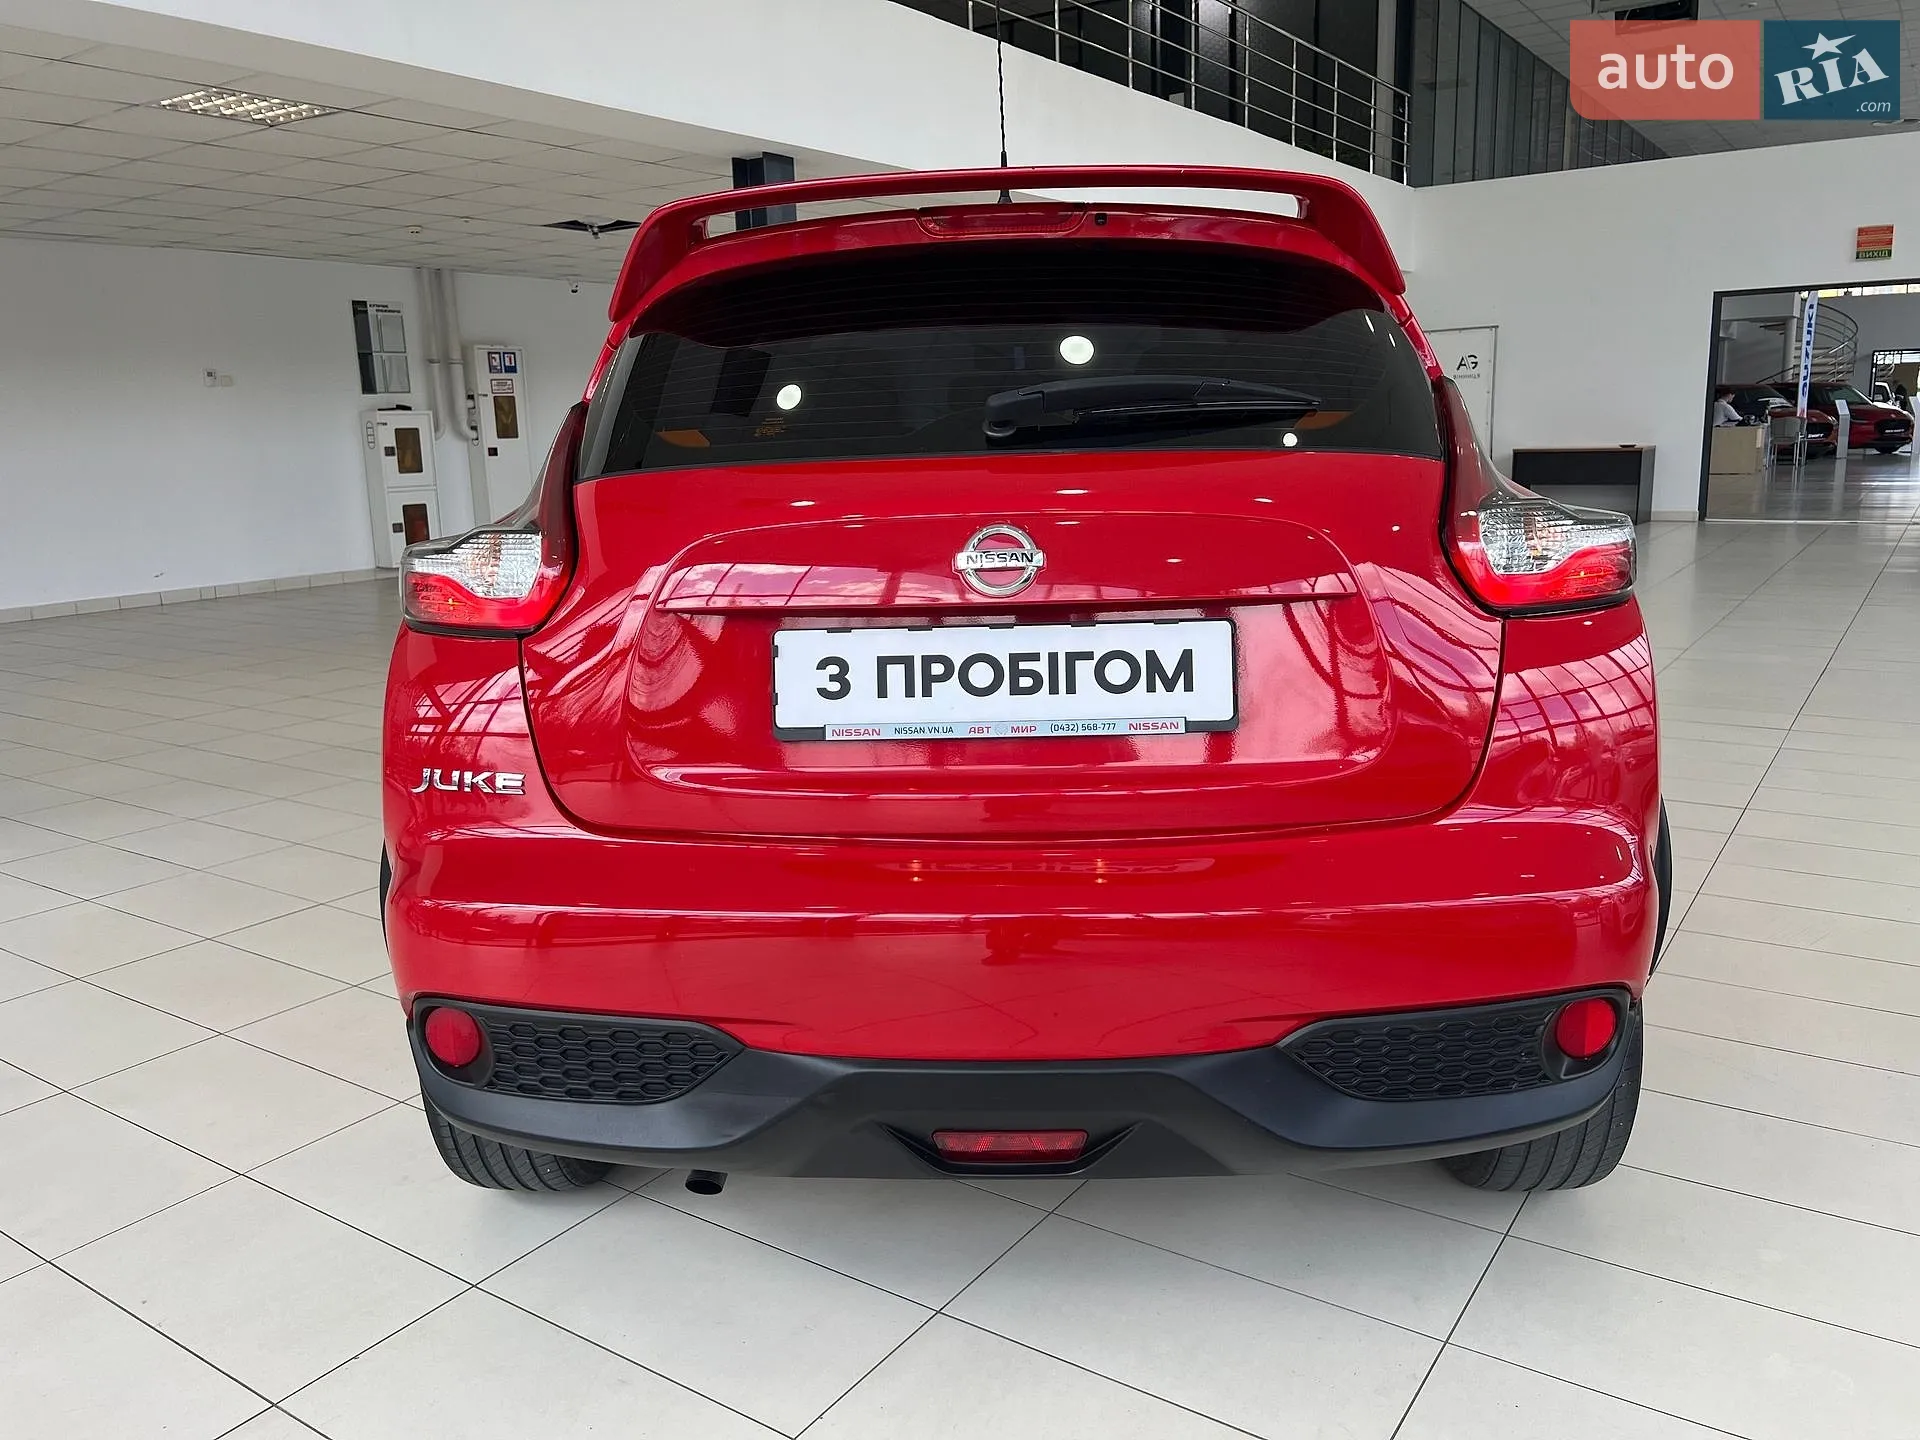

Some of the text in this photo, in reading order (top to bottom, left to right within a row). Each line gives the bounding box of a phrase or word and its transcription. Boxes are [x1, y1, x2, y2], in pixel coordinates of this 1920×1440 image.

[966, 551, 1035, 565] NISSAN
[876, 648, 1194, 699] ПРОБІГОМ
[831, 728, 881, 737] NISSAN
[894, 726, 954, 735] NISSAN.VN.UA
[1050, 723, 1079, 733] (0432)
[1081, 722, 1117, 731] 568-777
[1128, 721, 1179, 731] NISSAN
[410, 768, 526, 795] JUKE
